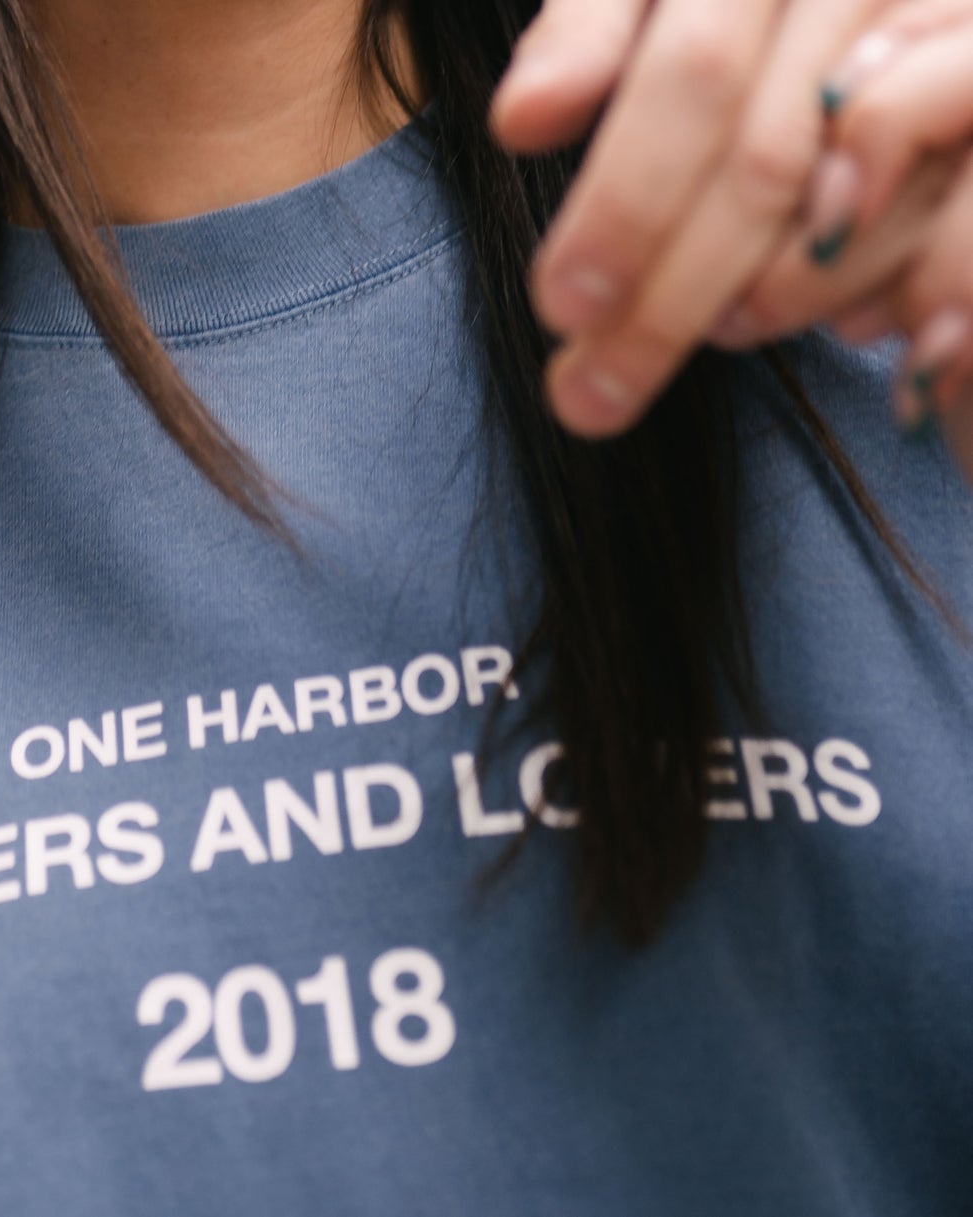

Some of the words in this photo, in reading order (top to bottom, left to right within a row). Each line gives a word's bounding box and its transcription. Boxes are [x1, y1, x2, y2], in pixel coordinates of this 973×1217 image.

[11, 701, 167, 780] ONE
[187, 645, 519, 749] HARBOR
[189, 763, 424, 872] AND
[452, 738, 882, 838] LOERS
[136, 947, 456, 1091] 2018
